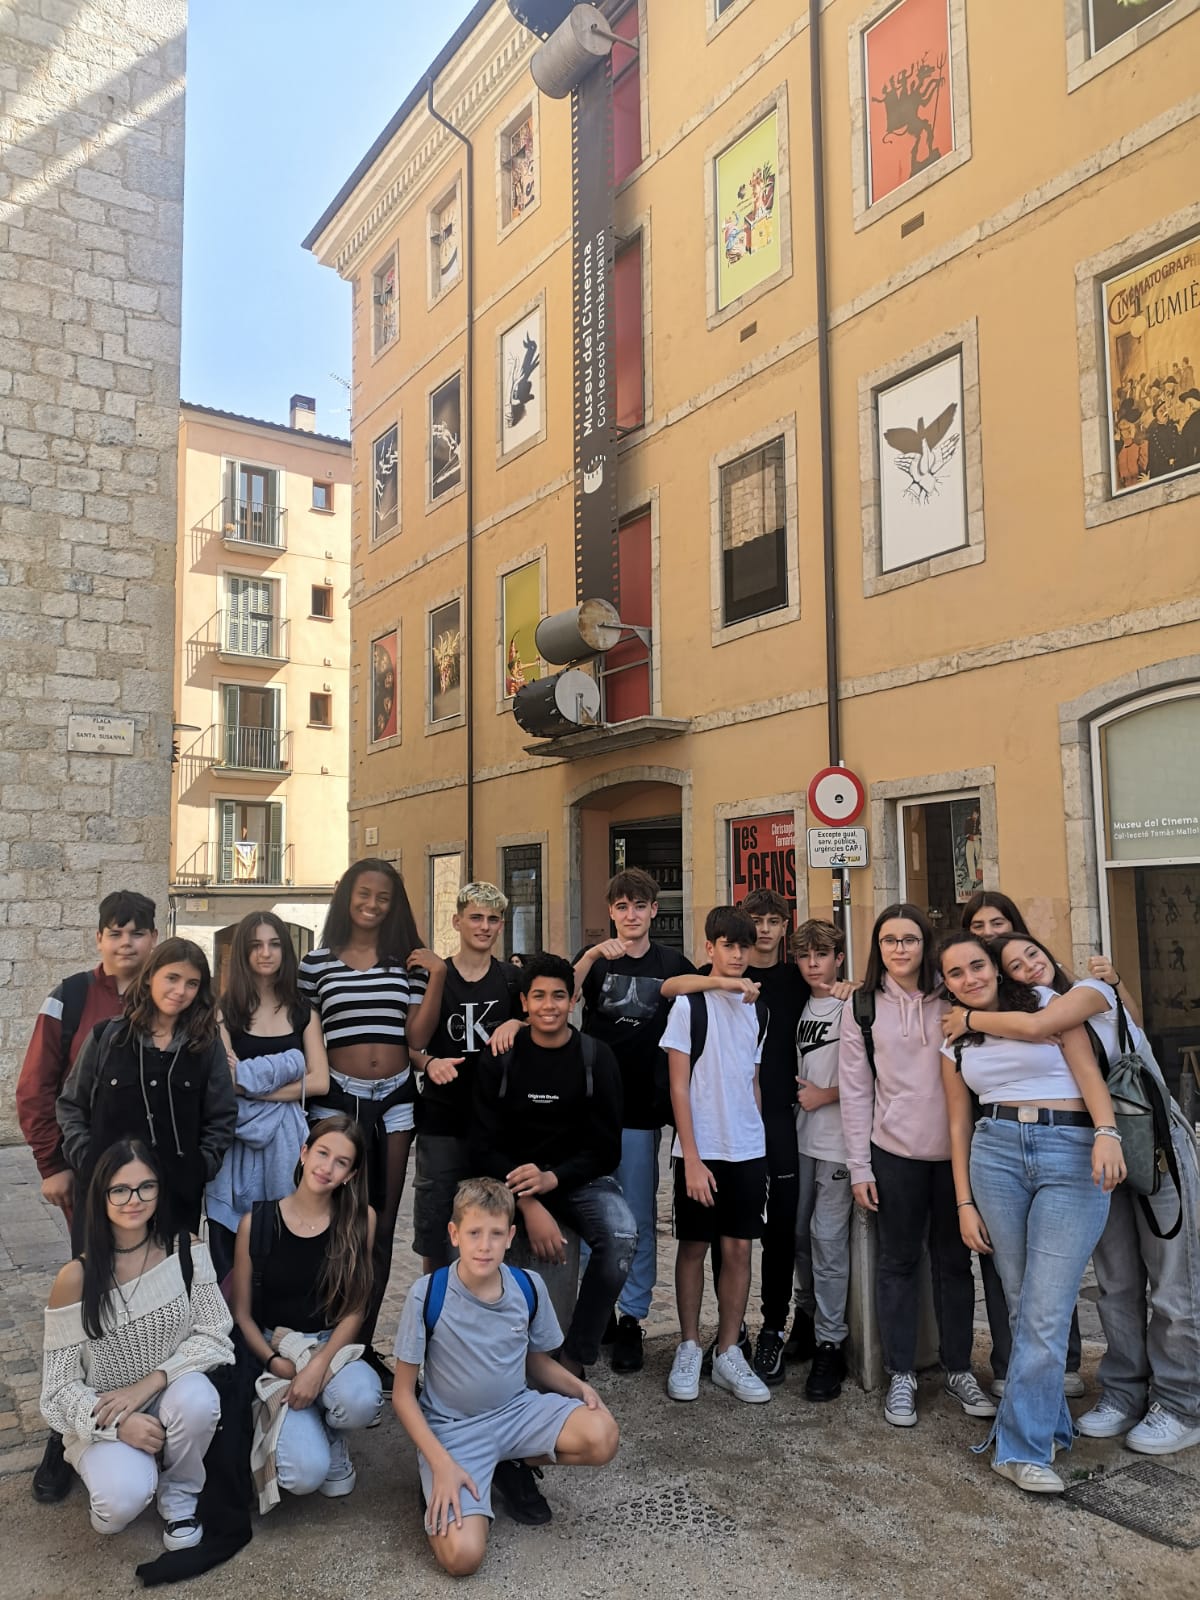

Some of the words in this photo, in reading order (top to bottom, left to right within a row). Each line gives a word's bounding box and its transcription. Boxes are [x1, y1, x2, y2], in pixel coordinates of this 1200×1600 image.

[596, 229, 605, 284] Mallol
[582, 240, 592, 327] Cinema
[595, 283, 605, 341] Tomàs
[582, 328, 592, 362] del
[583, 365, 593, 437] Museu
[1113, 822, 1142, 830] Museu
[1144, 819, 1159, 828] del
[1161, 817, 1199, 826] Cinema
[1151, 829, 1174, 837] Tomàs
[1177, 827, 1200, 835] Mallol
[747, 848, 796, 897] GENS
[447, 1000, 499, 1052] CK
[797, 1020, 832, 1044] NIKE
